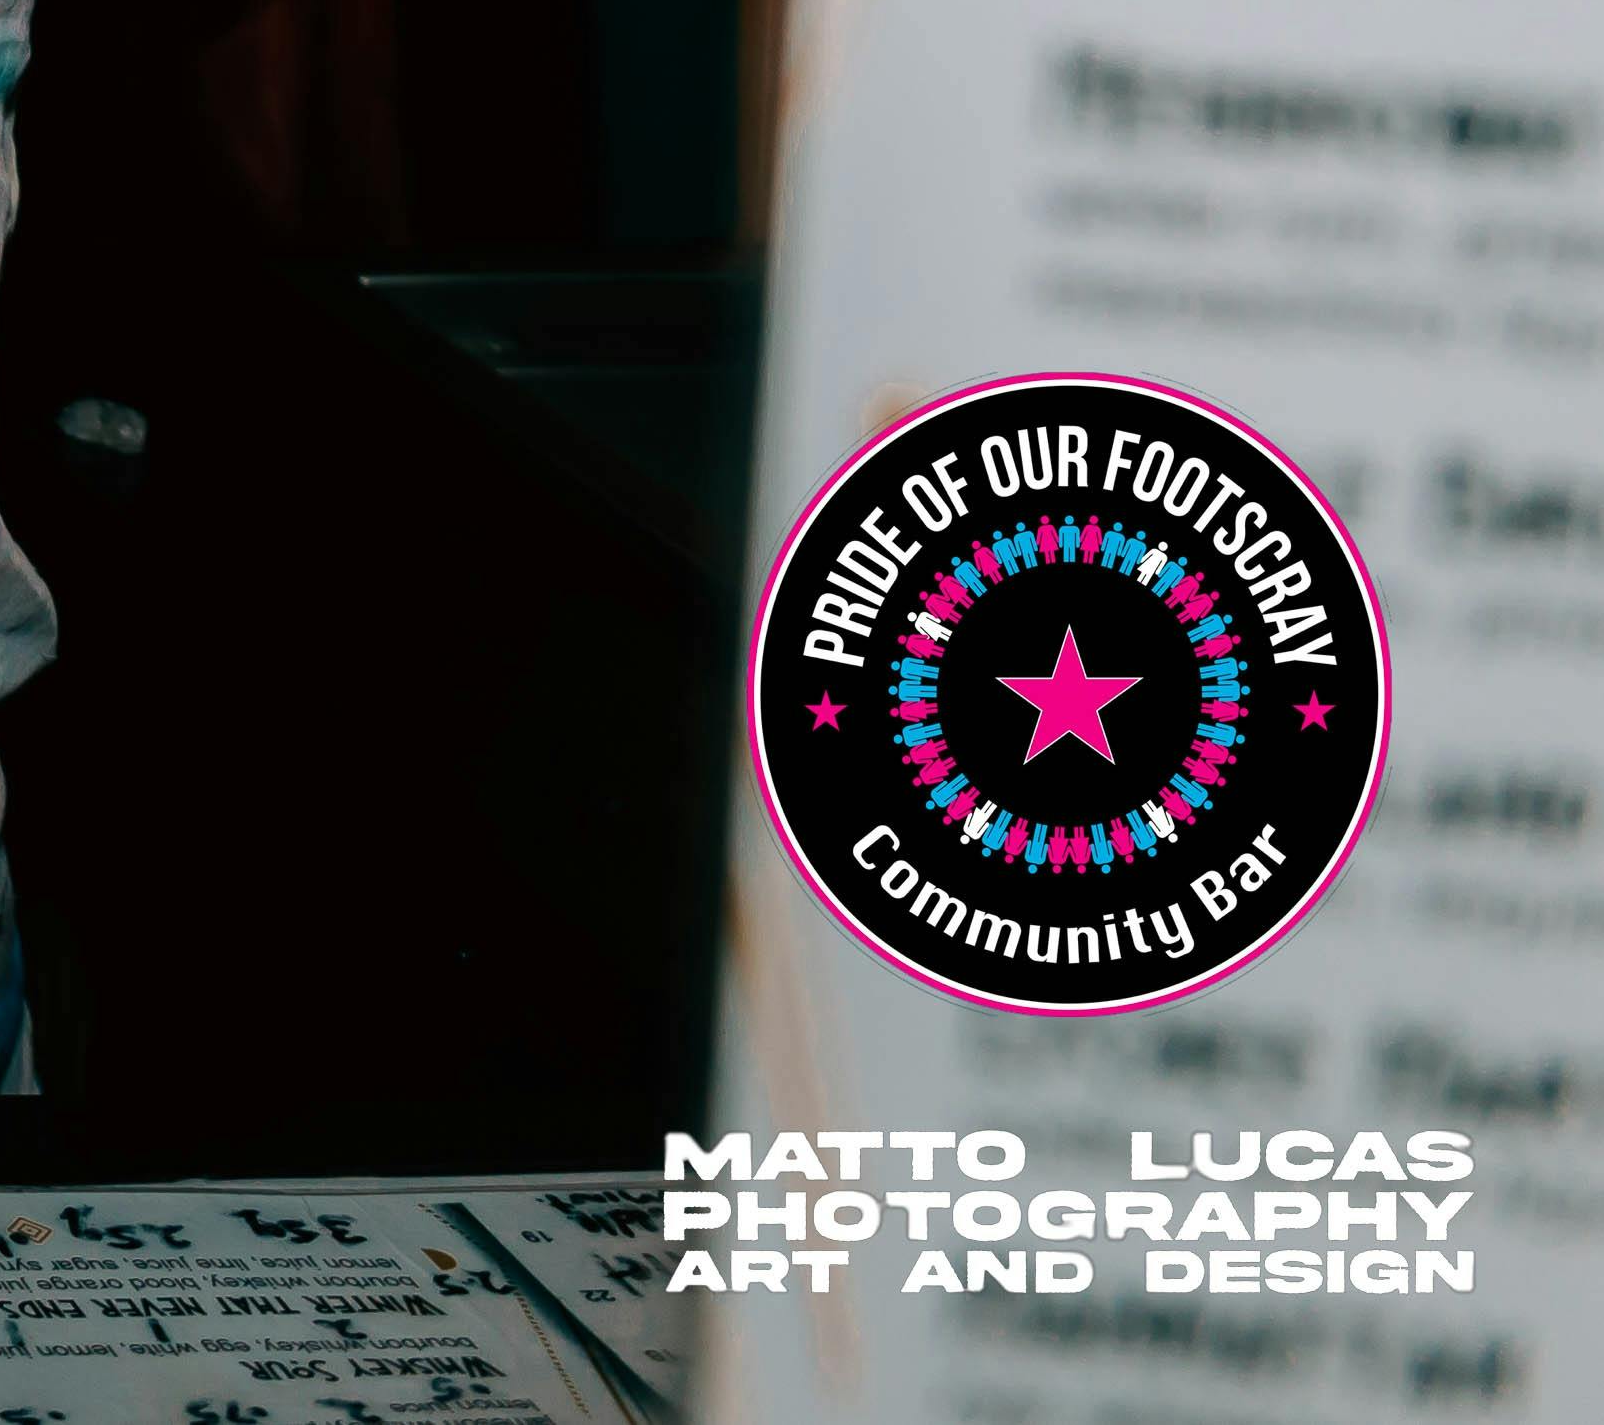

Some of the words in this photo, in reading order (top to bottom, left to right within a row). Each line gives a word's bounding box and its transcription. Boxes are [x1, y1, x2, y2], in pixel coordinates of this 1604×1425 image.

[521, 1231, 553, 1243] 19
[51, 1257, 119, 1271] sugar
[122, 1256, 192, 1271] juice,
[195, 1256, 250, 1270] lime
[251, 1255, 321, 1271] juice,
[323, 1256, 402, 1270] lemon
[37, 1277, 122, 1291] orange
[127, 1276, 201, 1290] blood
[203, 1274, 310, 1290] whiskey,
[316, 1275, 420, 1289] bourbon
[579, 1290, 616, 1302] 22
[90, 1296, 207, 1318] NEVER
[216, 1296, 301, 1316] THAT
[302, 1295, 449, 1316] WINTER
[119, 1341, 198, 1357] white,
[200, 1338, 250, 1352] egg
[255, 1337, 360, 1354] whiskey,
[369, 1336, 478, 1350] bourbon
[36, 1344, 119, 1357] lemon
[348, 1356, 507, 1378] WHISKEY
